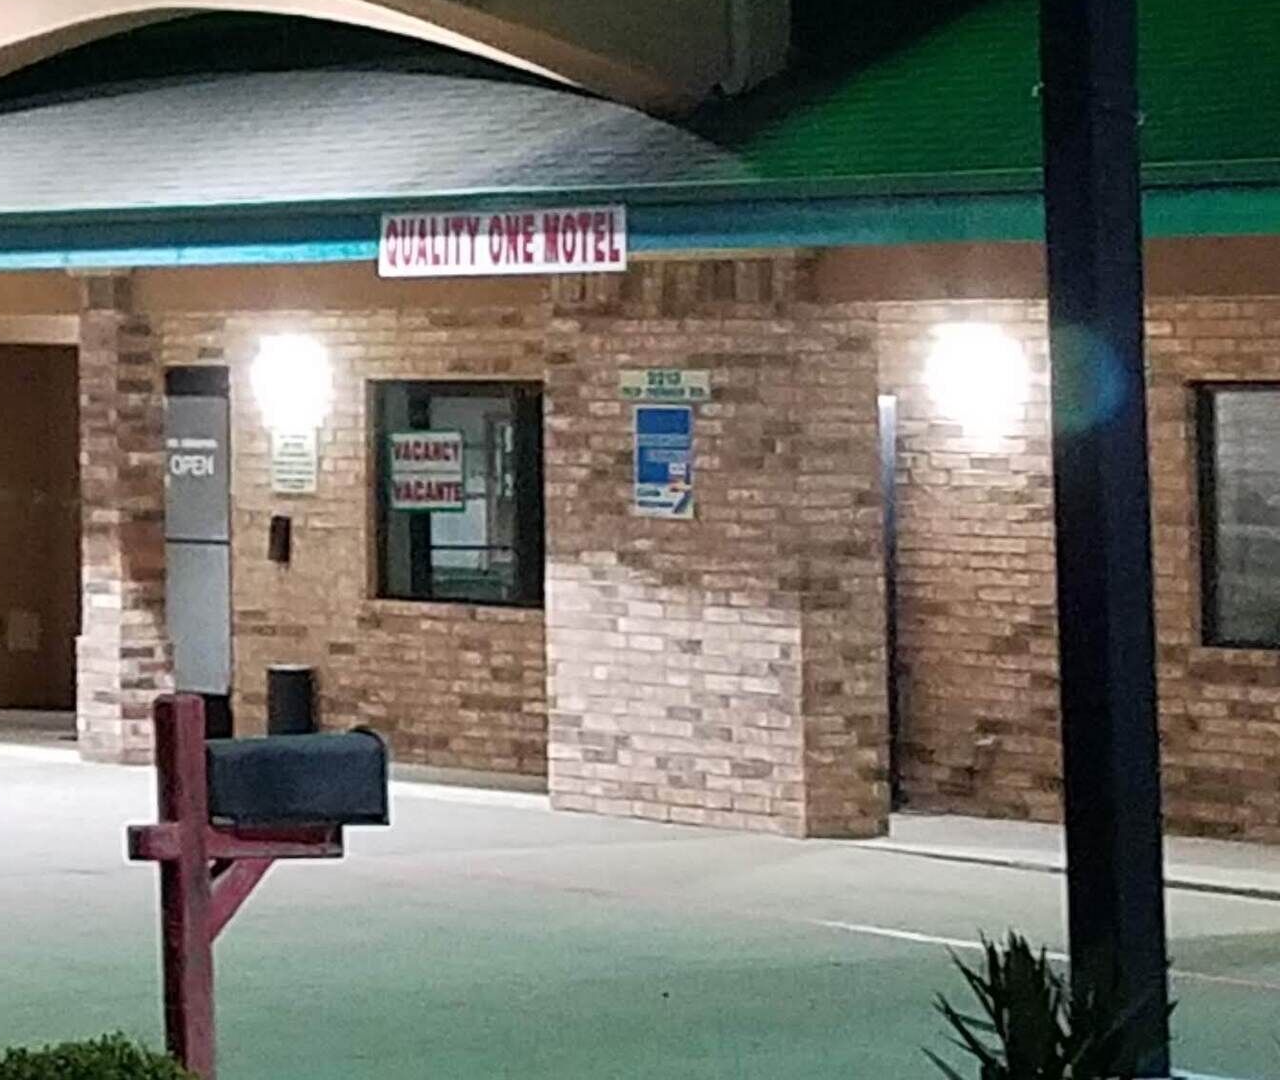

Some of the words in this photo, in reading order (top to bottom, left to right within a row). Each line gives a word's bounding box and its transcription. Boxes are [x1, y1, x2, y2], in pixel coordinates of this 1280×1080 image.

[386, 218, 479, 267] QUALITY
[489, 215, 535, 264] ONE
[544, 212, 620, 263] MOTEL
[394, 440, 460, 462] VACANCY
[169, 455, 214, 475] OPEN
